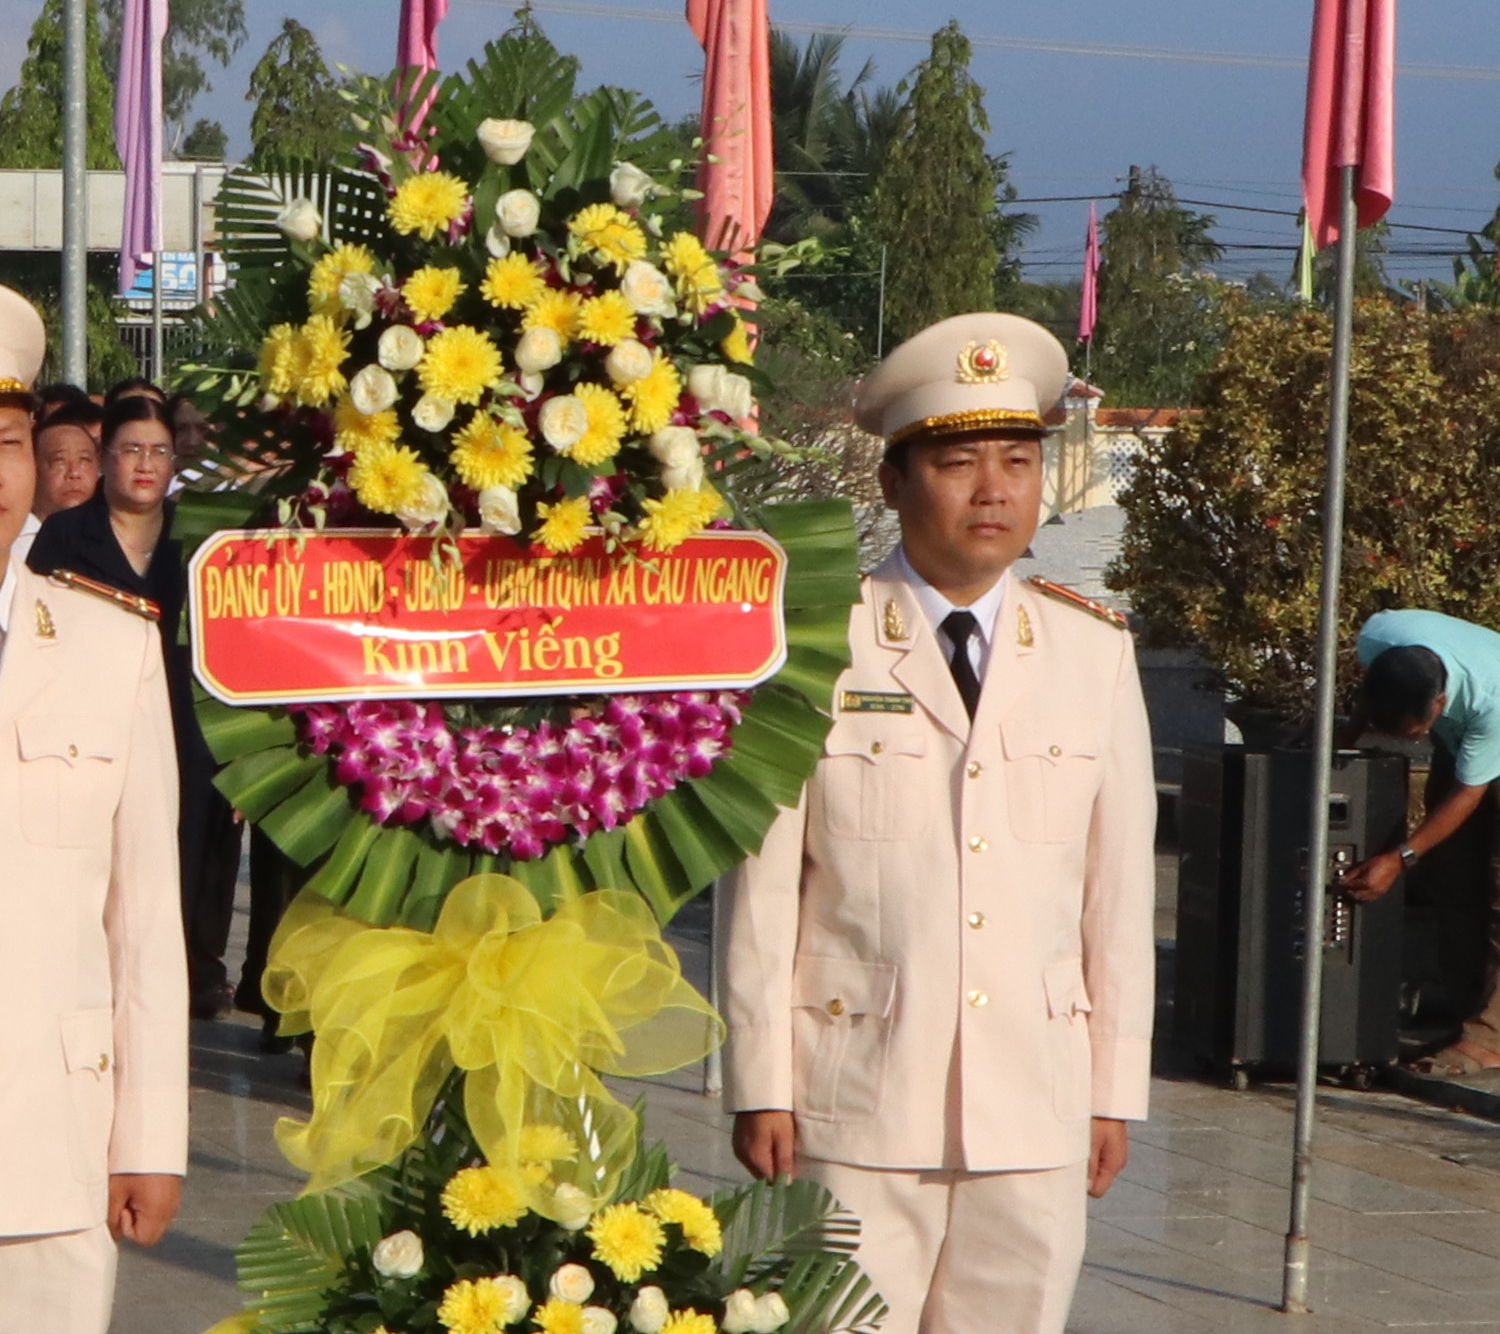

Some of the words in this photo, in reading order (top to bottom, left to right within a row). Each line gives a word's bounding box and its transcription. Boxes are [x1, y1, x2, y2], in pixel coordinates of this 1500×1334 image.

[206, 546, 270, 619] ĐẢNG
[323, 560, 386, 615] HĐND
[405, 560, 466, 612] UBND
[692, 557, 773, 605] NGANG
[481, 615, 625, 679] Viếng
